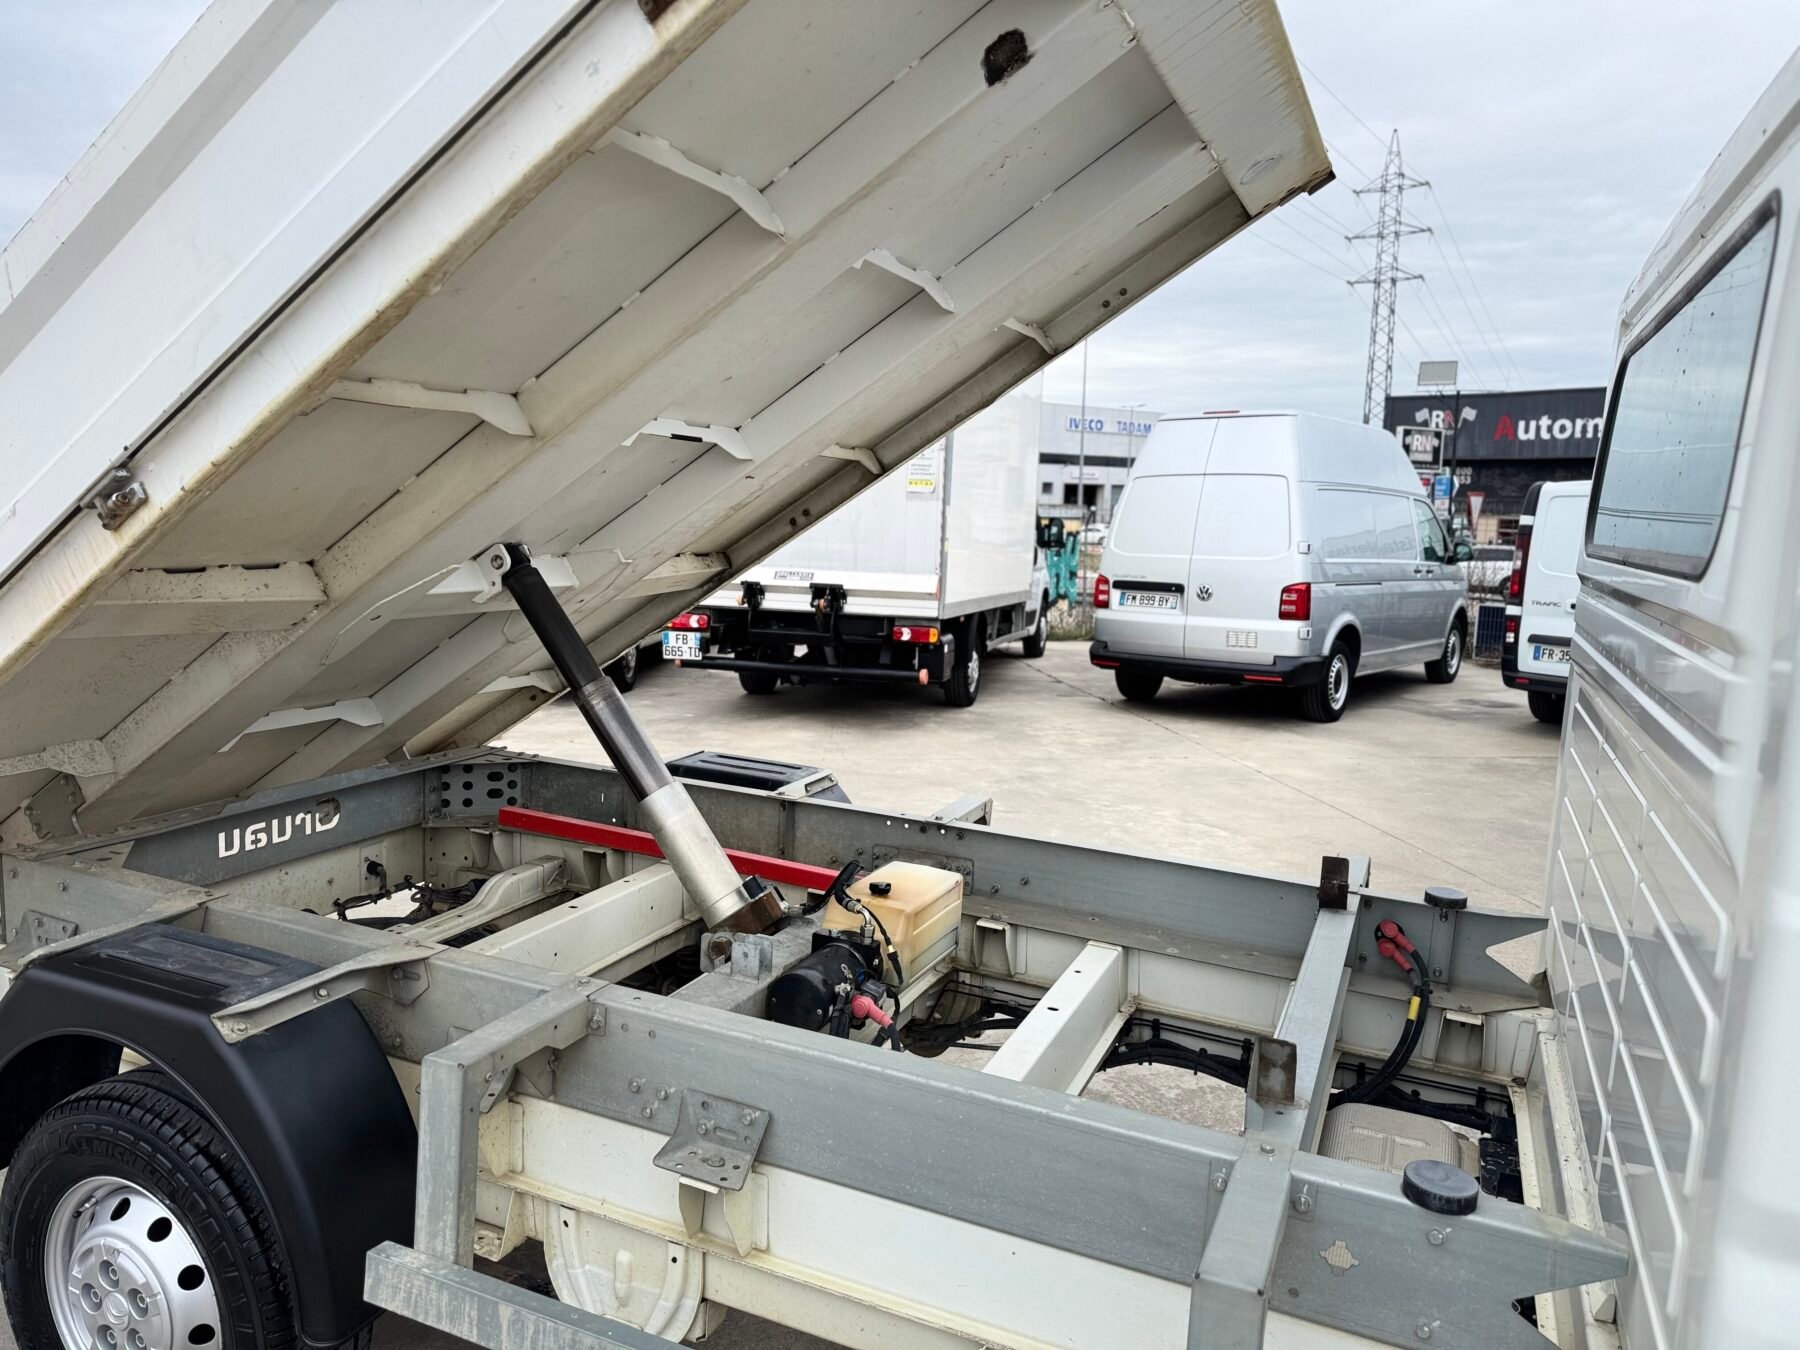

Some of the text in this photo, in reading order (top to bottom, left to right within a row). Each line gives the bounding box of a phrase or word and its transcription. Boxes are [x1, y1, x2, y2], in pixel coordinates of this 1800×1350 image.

[1069, 417, 1104, 431] IVECO
[1412, 434, 1432, 451] RN
[1531, 600, 1563, 608] TRAFIC
[92, 1141, 178, 1200] MICHELIN
